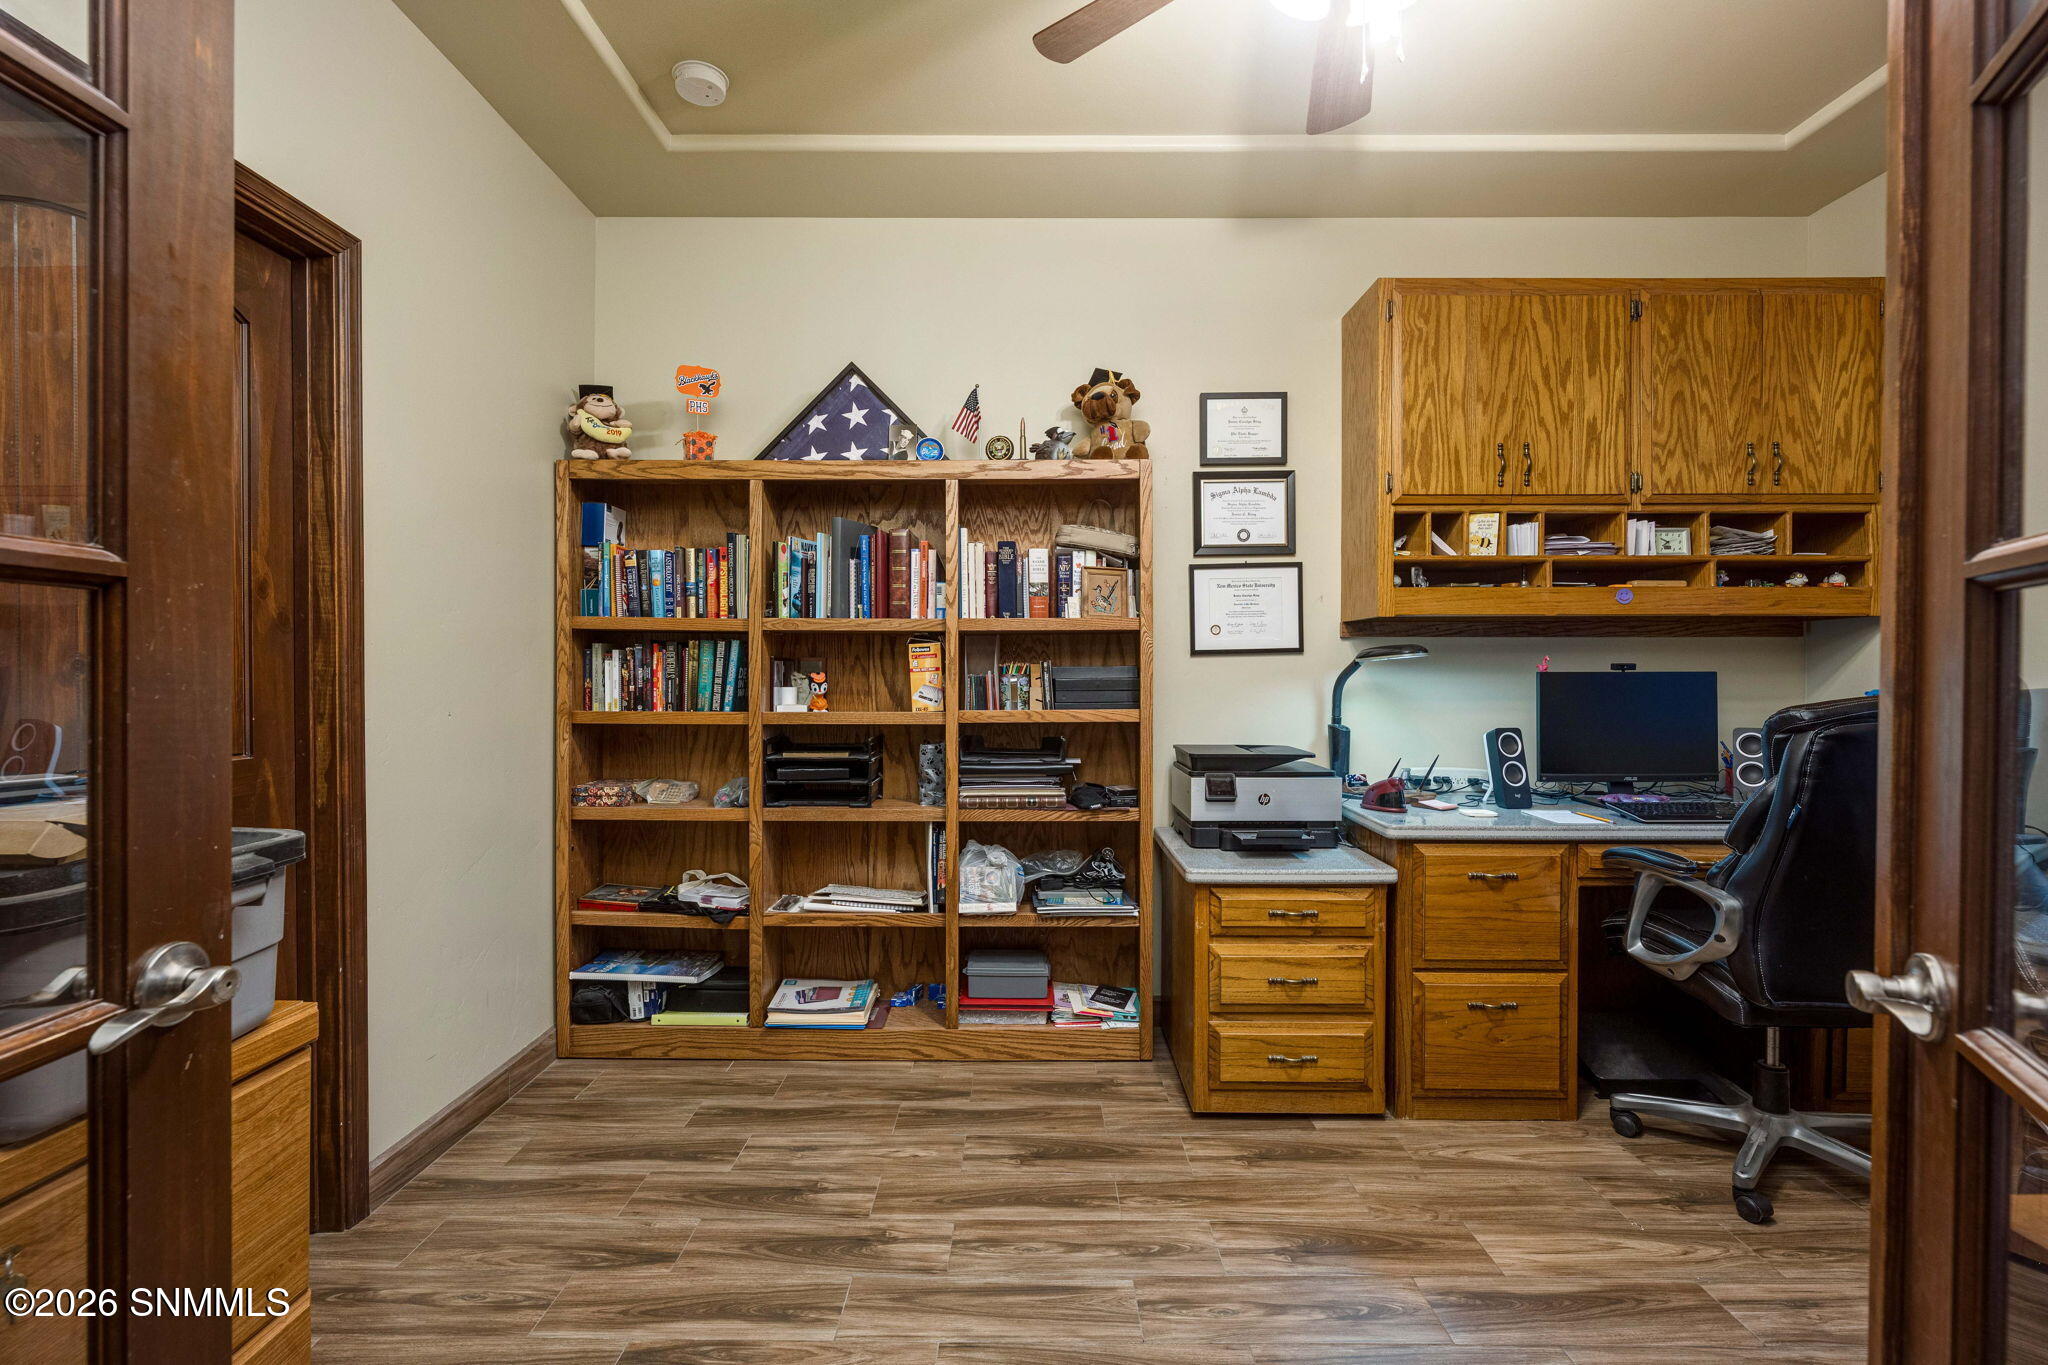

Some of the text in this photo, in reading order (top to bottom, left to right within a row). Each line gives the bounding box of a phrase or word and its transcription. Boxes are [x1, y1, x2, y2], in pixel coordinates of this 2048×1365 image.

[678, 371, 720, 386] Blackhawks
[688, 400, 708, 413] PHS
[606, 429, 622, 437] 2019
[1209, 486, 1277, 502] Sigma Alpha Lambda
[665, 556, 673, 593] ASTROLOGY KIT
[665, 651, 675, 679] GENERALS
[1259, 794, 1270, 805] hp
